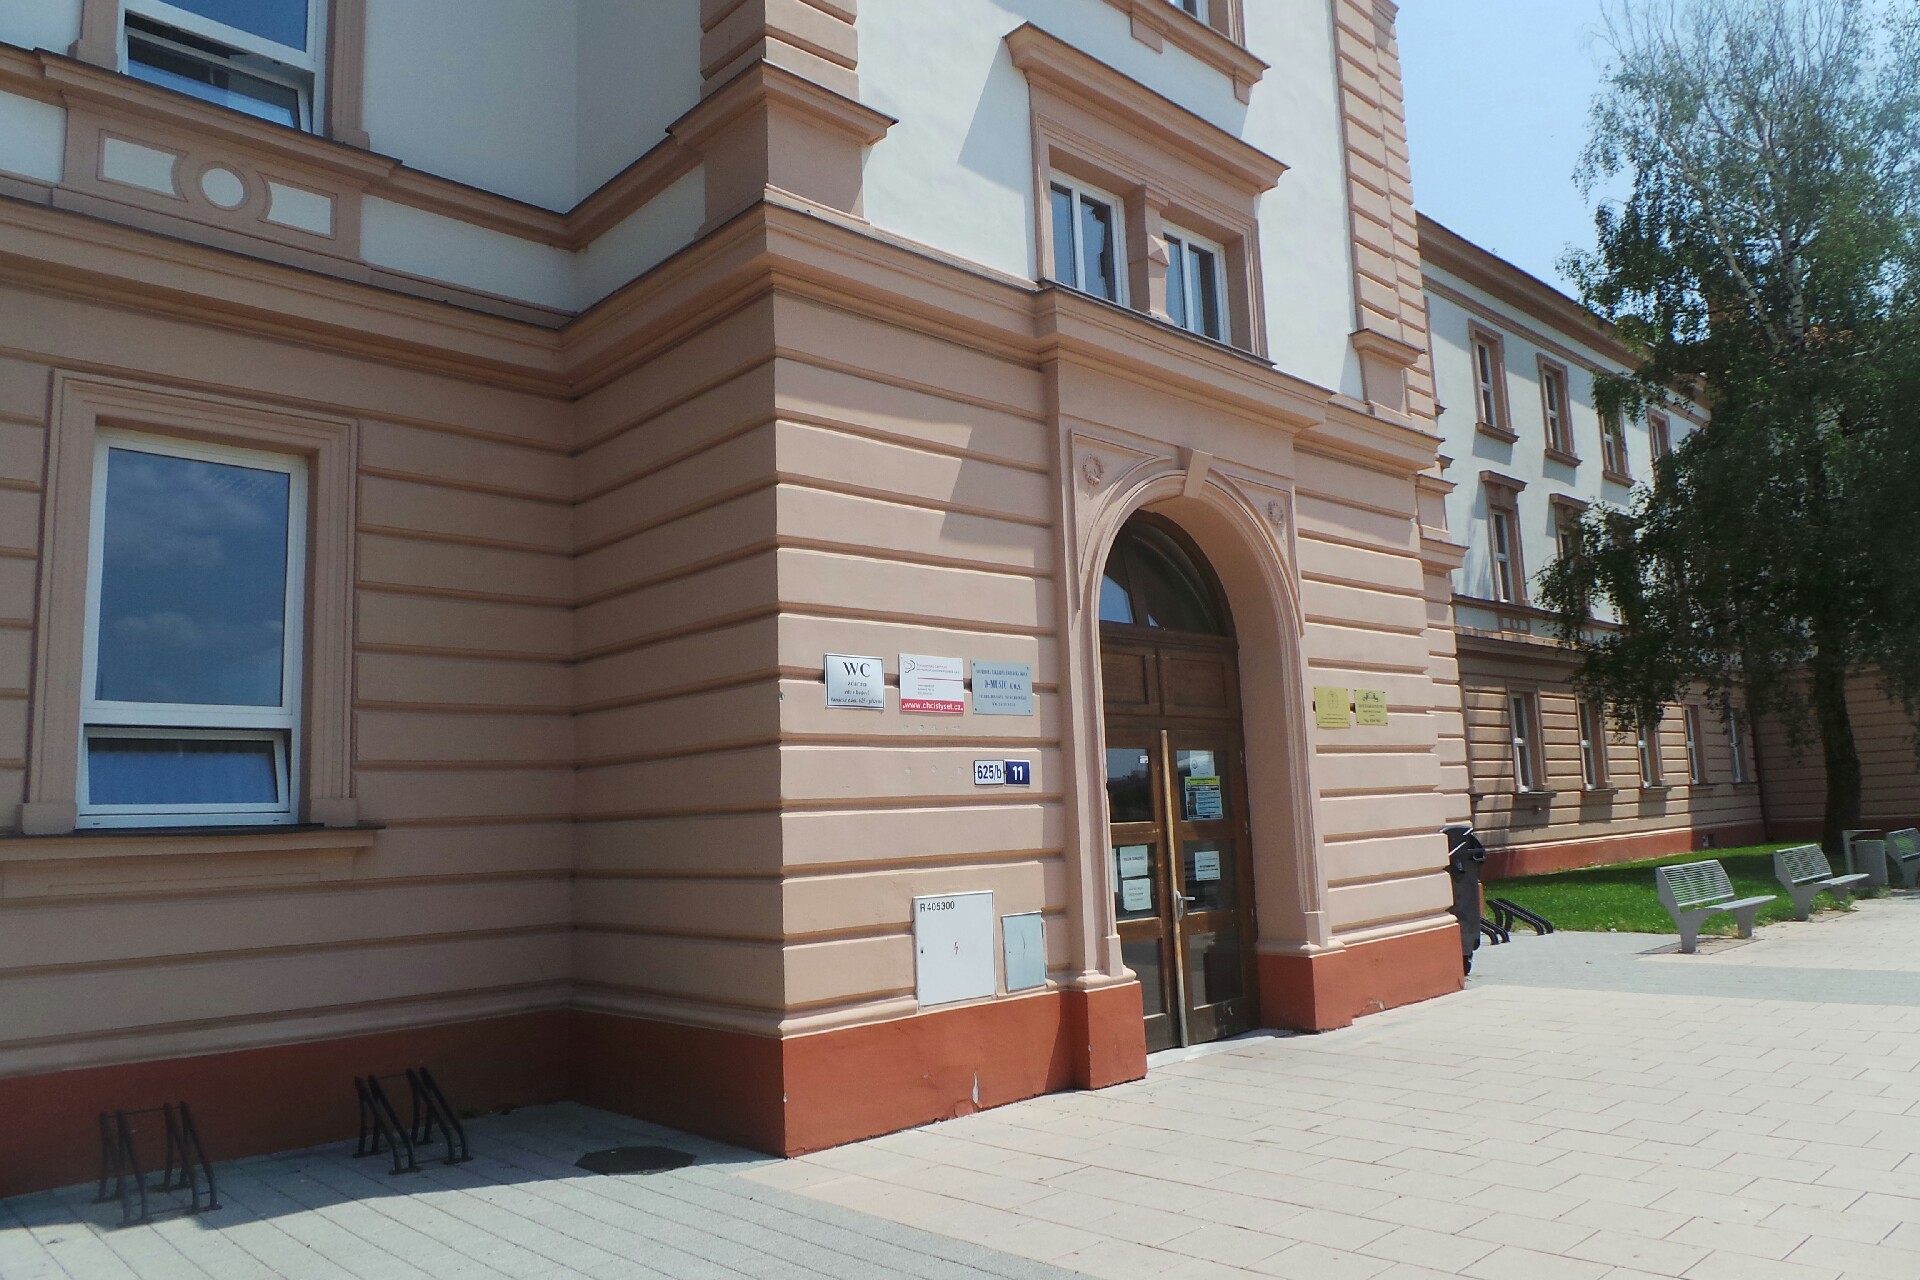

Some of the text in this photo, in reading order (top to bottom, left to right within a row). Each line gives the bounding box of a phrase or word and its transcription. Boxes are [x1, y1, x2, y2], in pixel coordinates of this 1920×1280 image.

[843, 661, 870, 678] WC
[977, 764, 1023, 781] 625/b 11
[927, 901, 955, 911] 405300
